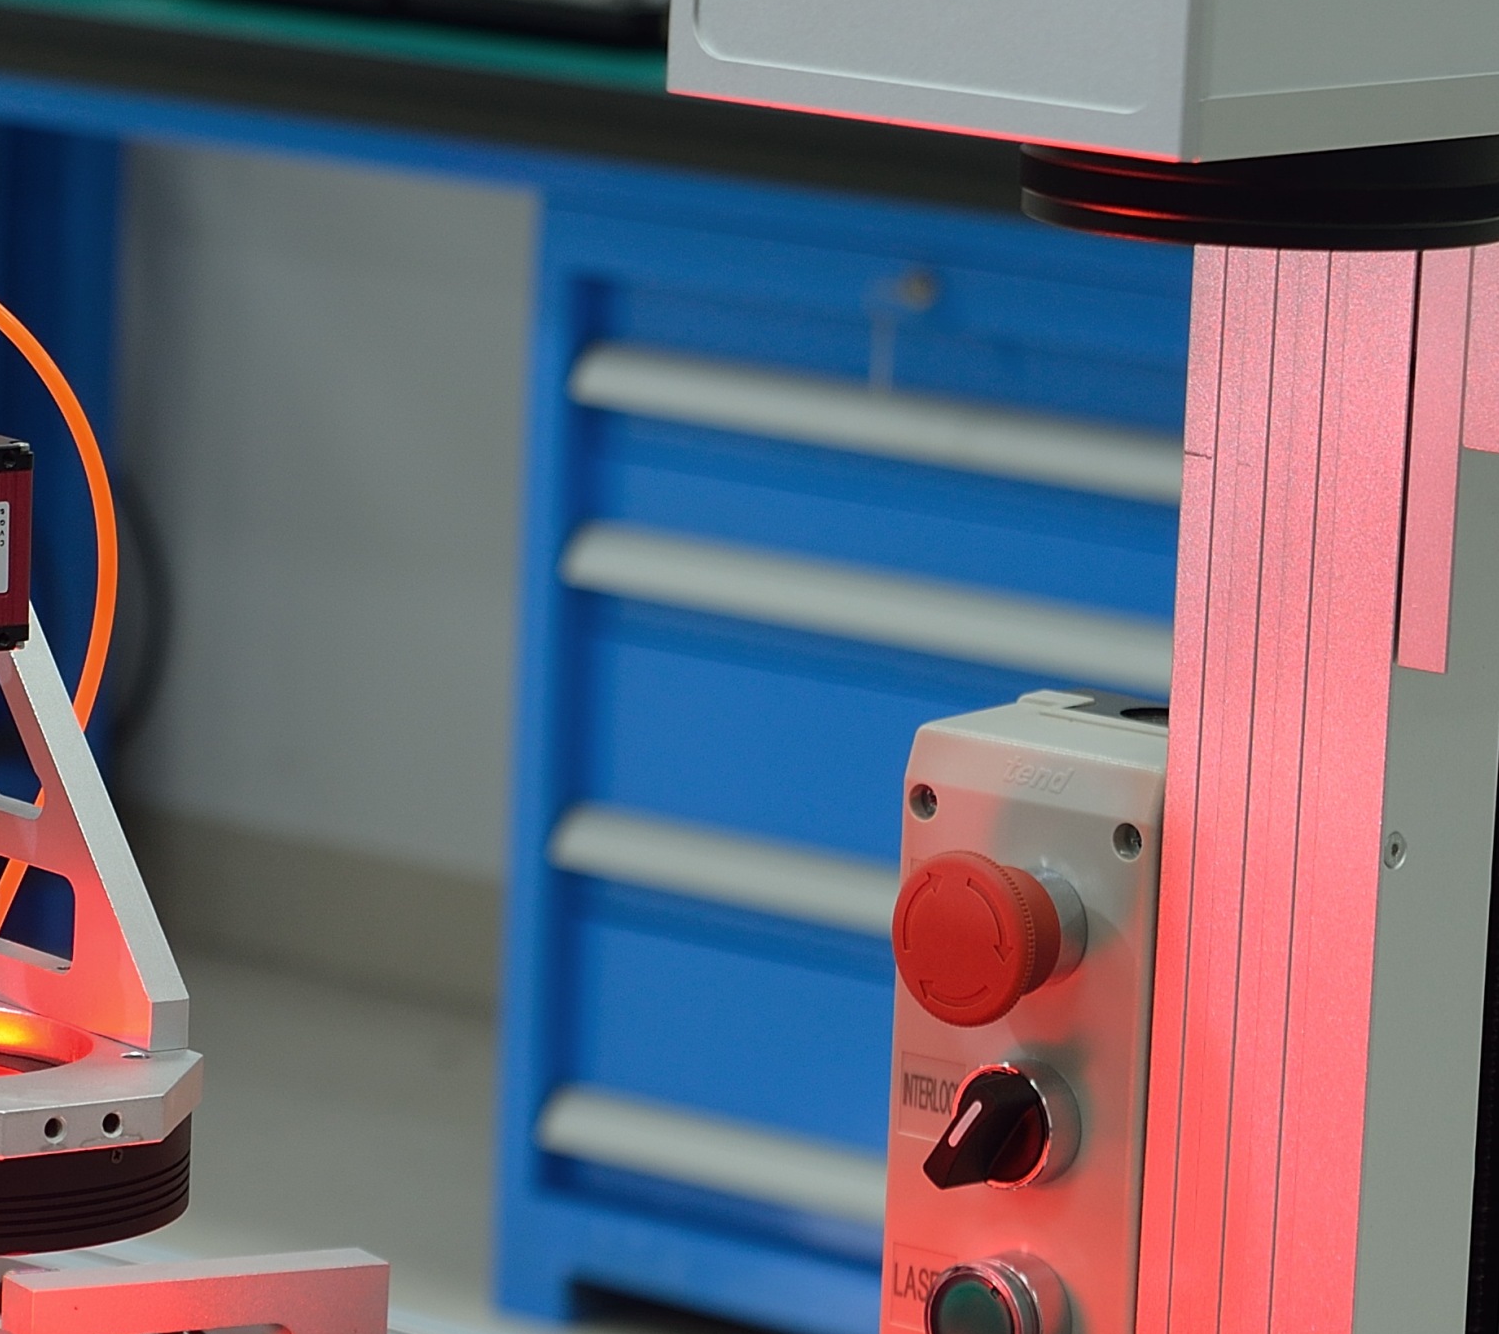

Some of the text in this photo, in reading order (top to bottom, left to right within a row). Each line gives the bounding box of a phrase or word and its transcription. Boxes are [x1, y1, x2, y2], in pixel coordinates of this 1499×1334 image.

[1002, 754, 1076, 795] tend
[902, 1071, 959, 1115] INTERLOC
[893, 1262, 938, 1304] LAS
